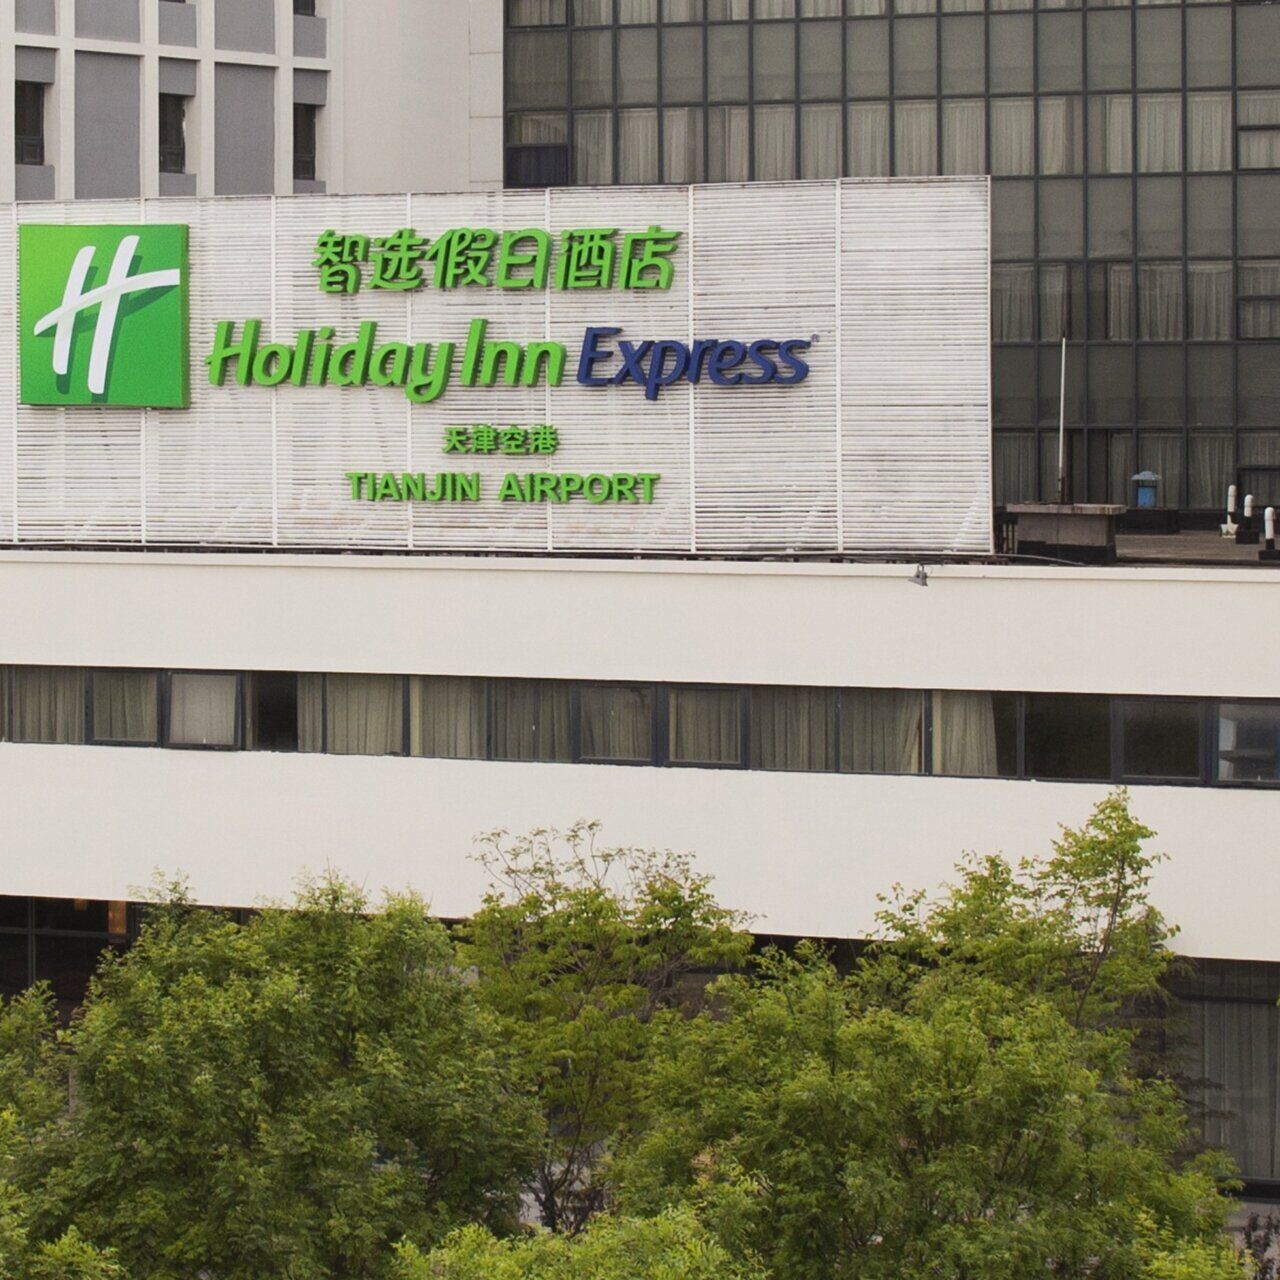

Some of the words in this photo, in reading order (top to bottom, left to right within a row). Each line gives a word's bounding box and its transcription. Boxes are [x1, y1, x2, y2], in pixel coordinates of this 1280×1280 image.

[314, 225, 682, 294] 智选假日酒店
[204, 320, 455, 404] Holiday
[461, 318, 567, 388] Inn
[577, 327, 810, 399] Express
[443, 424, 559, 455] 天津空港
[346, 471, 481, 503] TIANJIN
[497, 472, 661, 504] AIRPORT
